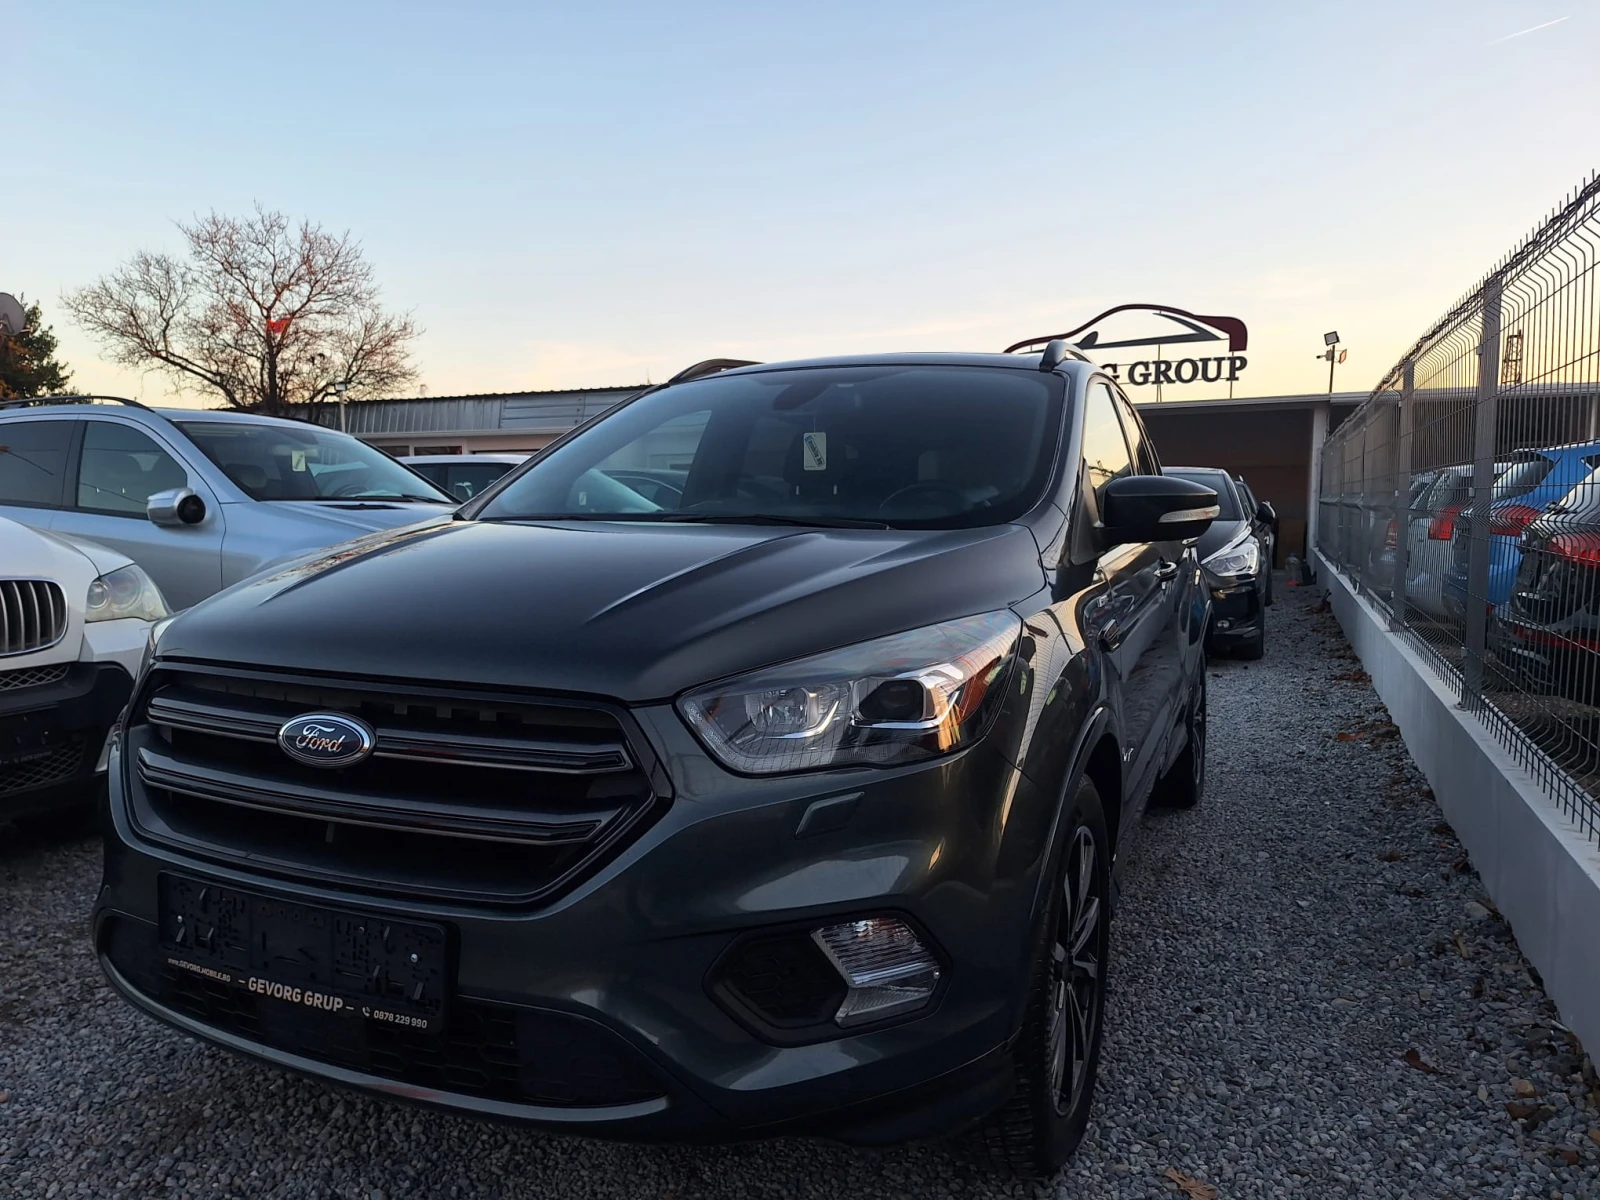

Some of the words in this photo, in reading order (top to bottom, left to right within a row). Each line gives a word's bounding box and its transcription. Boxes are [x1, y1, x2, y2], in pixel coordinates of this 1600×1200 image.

[1128, 356, 1247, 386] GROUP
[296, 724, 345, 752] Ford
[248, 976, 301, 1003] GEVORG
[304, 990, 343, 1012] GRUP
[394, 1014, 410, 1025] 229
[411, 1017, 428, 1029] 990
